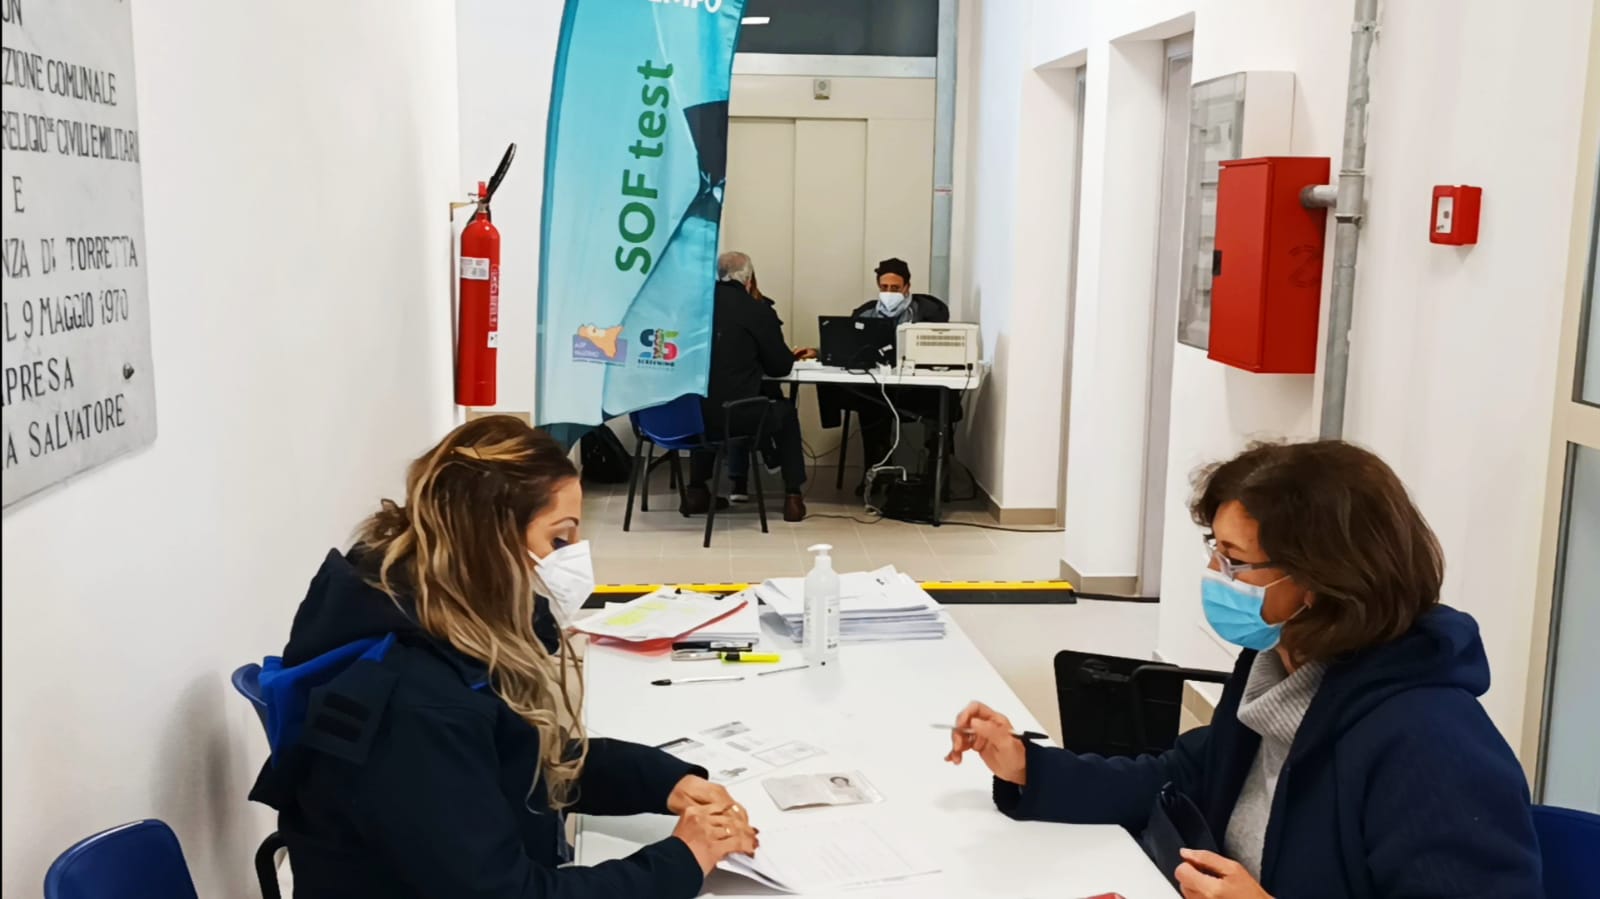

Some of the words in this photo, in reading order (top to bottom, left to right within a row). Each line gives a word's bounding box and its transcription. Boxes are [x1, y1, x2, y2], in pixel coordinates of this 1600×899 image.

[47, 58, 117, 106] COMUNALE
[628, 59, 674, 159] test
[12, 175, 24, 213] E
[615, 169, 658, 275] SOF
[66, 235, 138, 271] TORRETTA
[22, 300, 33, 338] 9
[40, 291, 94, 336] MAGGIO
[99, 288, 129, 325] 1970
[2, 356, 74, 407] PRESA
[28, 393, 125, 458] SALVATORE
